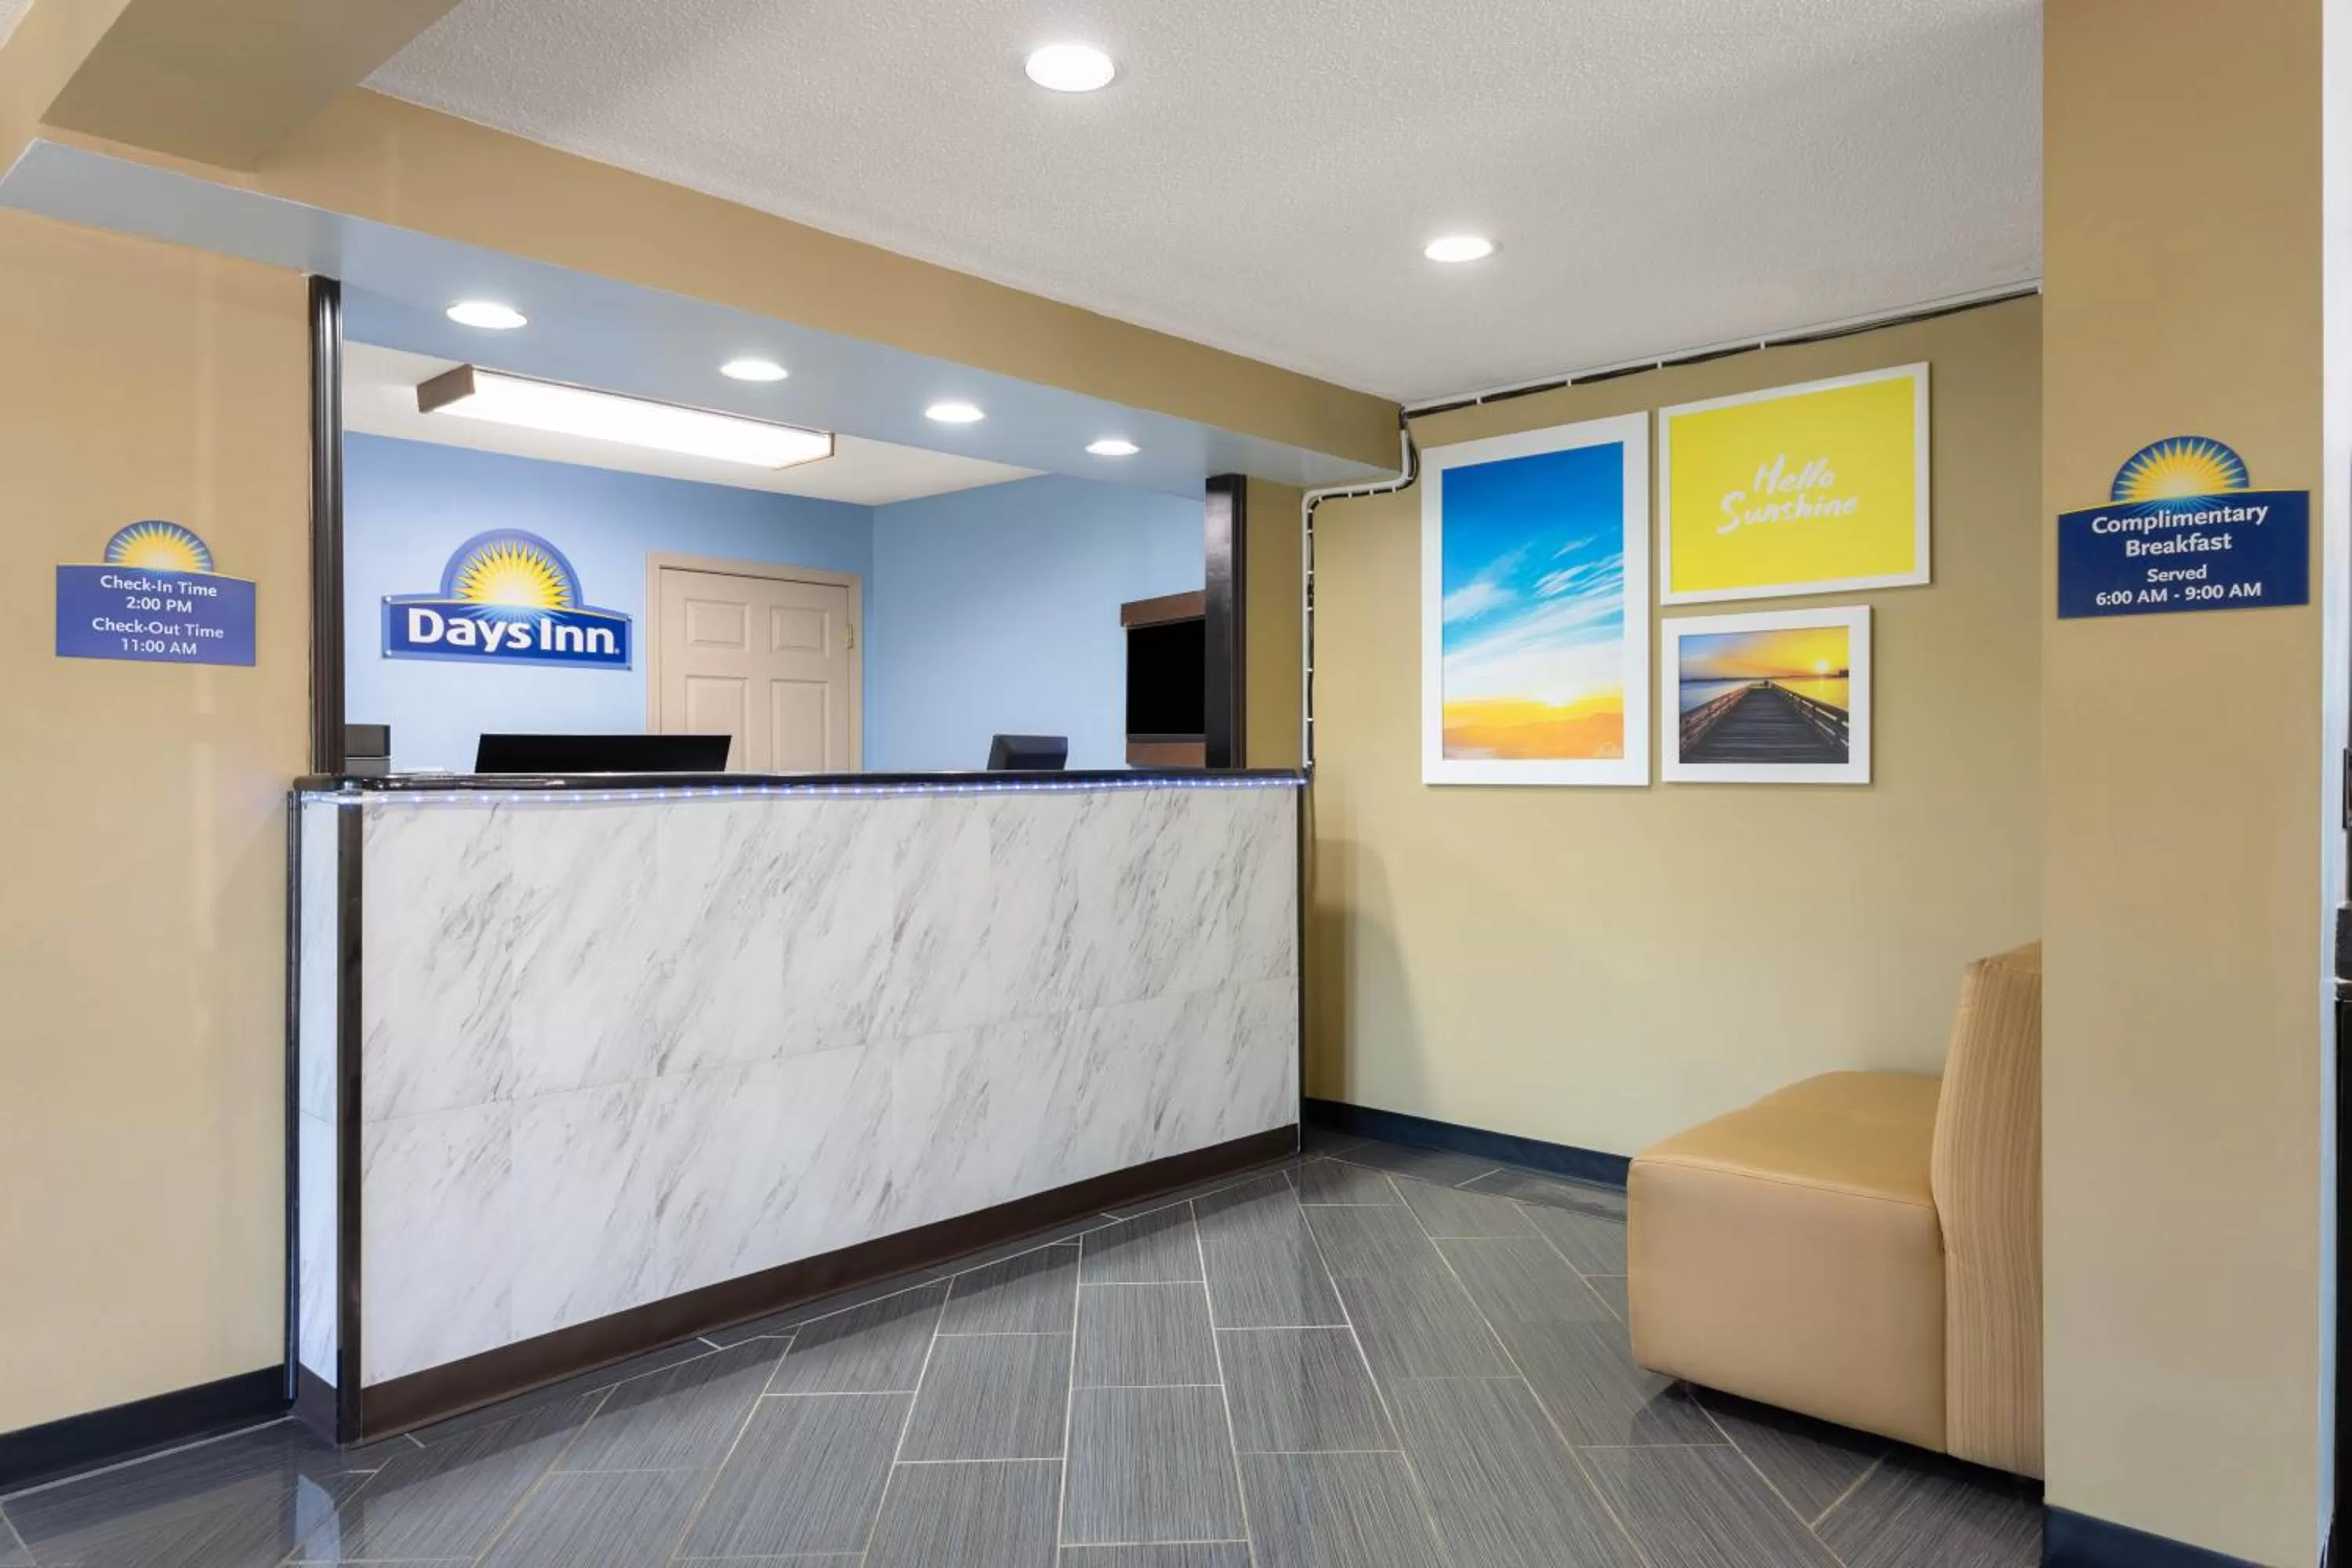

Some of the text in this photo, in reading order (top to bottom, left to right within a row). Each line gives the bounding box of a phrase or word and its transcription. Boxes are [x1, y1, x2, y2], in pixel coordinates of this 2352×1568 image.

[1753, 454, 1835, 495] Hello
[1715, 491, 1858, 535] Sunshine
[2091, 505, 2269, 535] Complimentary
[2125, 532, 2233, 557] Breakfast
[2147, 564, 2208, 583] Served
[100, 575, 218, 597] Check-In Time
[2095, 590, 2132, 606] 6:00
[2136, 589, 2168, 604] AM
[2185, 585, 2224, 601] 9:00
[2229, 582, 2262, 597] AM
[125, 596, 193, 613] 2:00 PM
[92, 617, 224, 639] Check-Out Time
[408, 608, 615, 655] Days Inn
[122, 638, 197, 655] 11:00 AM
